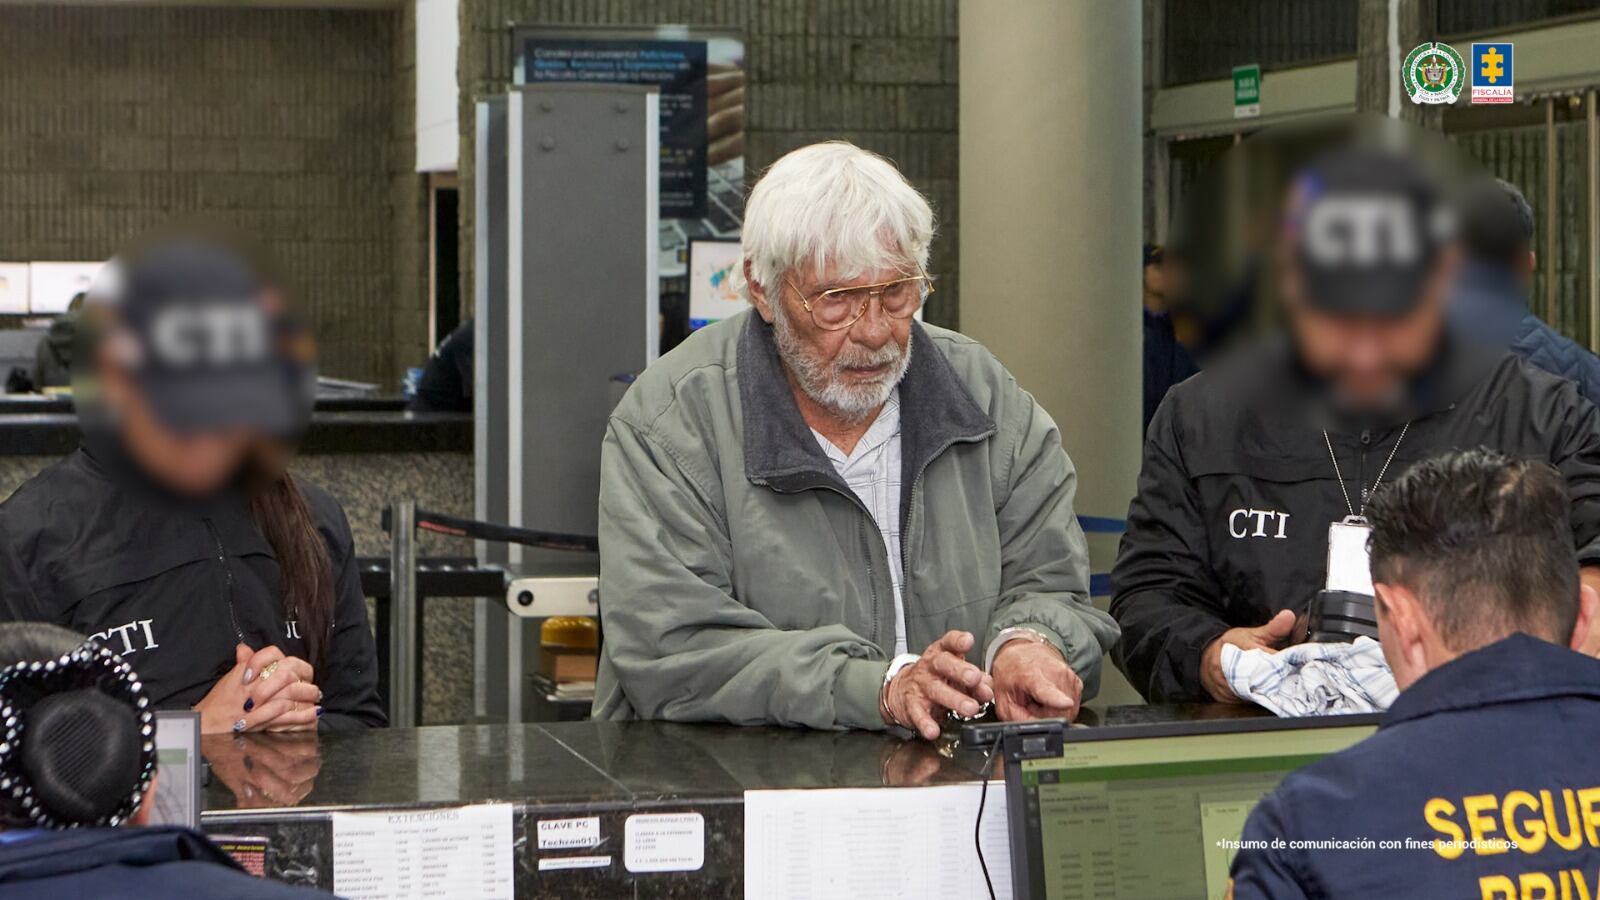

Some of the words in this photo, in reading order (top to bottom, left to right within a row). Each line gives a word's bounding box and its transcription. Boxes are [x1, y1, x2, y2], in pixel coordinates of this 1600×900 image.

[1309, 196, 1416, 265] CTI
[1229, 508, 1290, 538] CTI
[541, 821, 573, 831] CLAVE
[575, 820, 590, 829] PC
